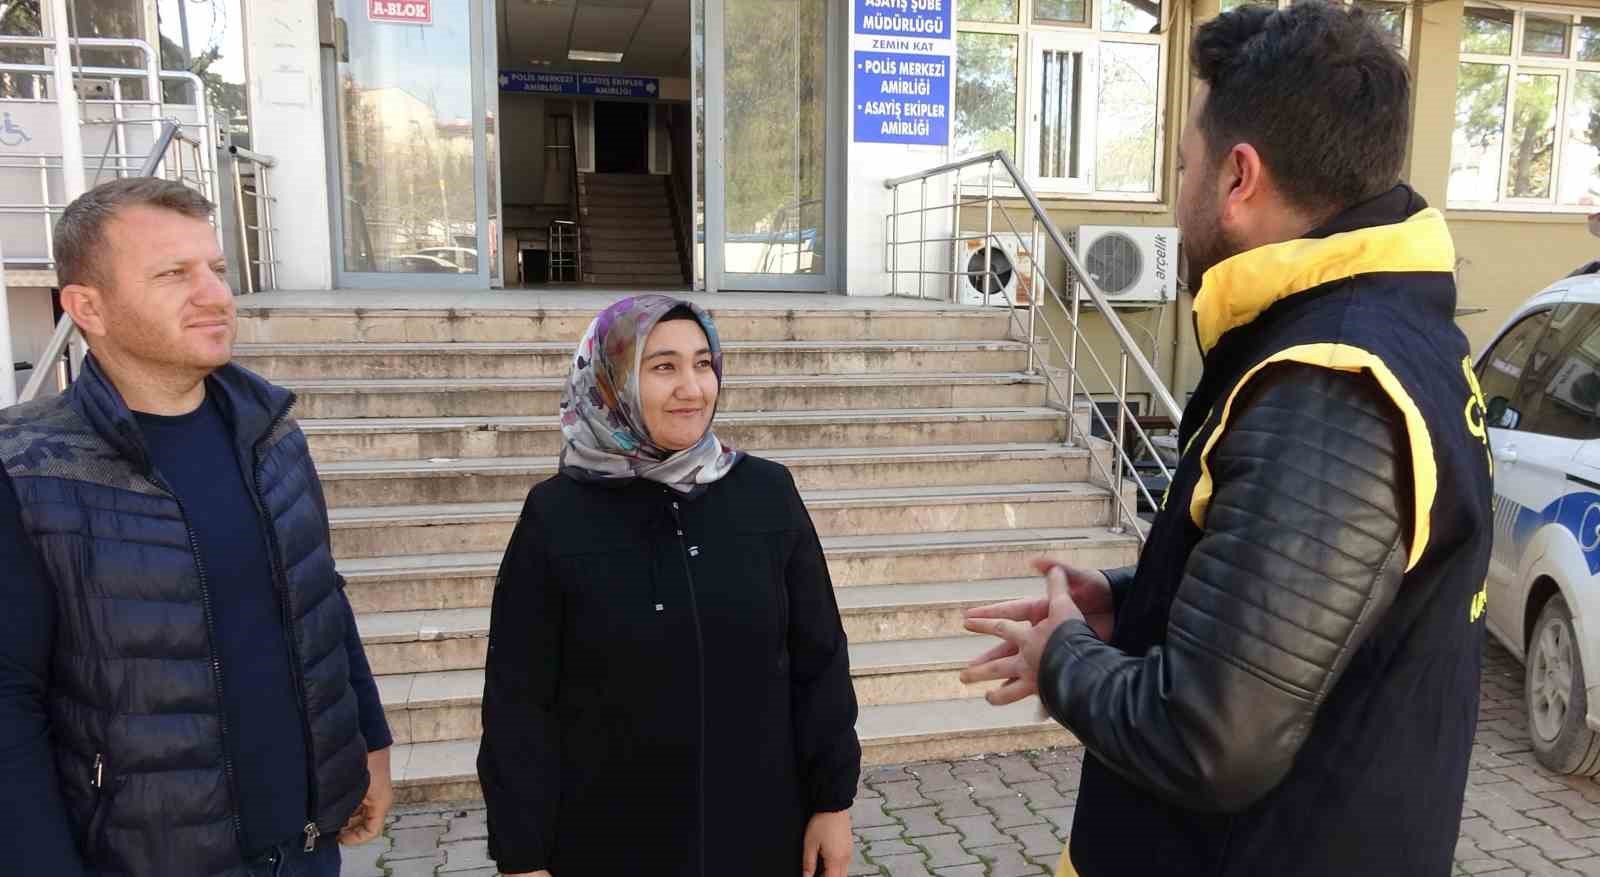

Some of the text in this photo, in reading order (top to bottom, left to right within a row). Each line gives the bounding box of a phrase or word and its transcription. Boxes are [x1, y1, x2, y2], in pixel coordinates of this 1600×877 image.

[374, 1, 426, 17] A-BLOK
[912, 42, 935, 51] KAT
[865, 57, 945, 77] POLİS MERKEZİ
[880, 77, 930, 96] AMİRLİĞİ
[864, 99, 945, 120] ASAYİŞ EKİPLER
[880, 119, 930, 136] AMİRLİĞİ
[1154, 234, 1168, 280] arçelik
